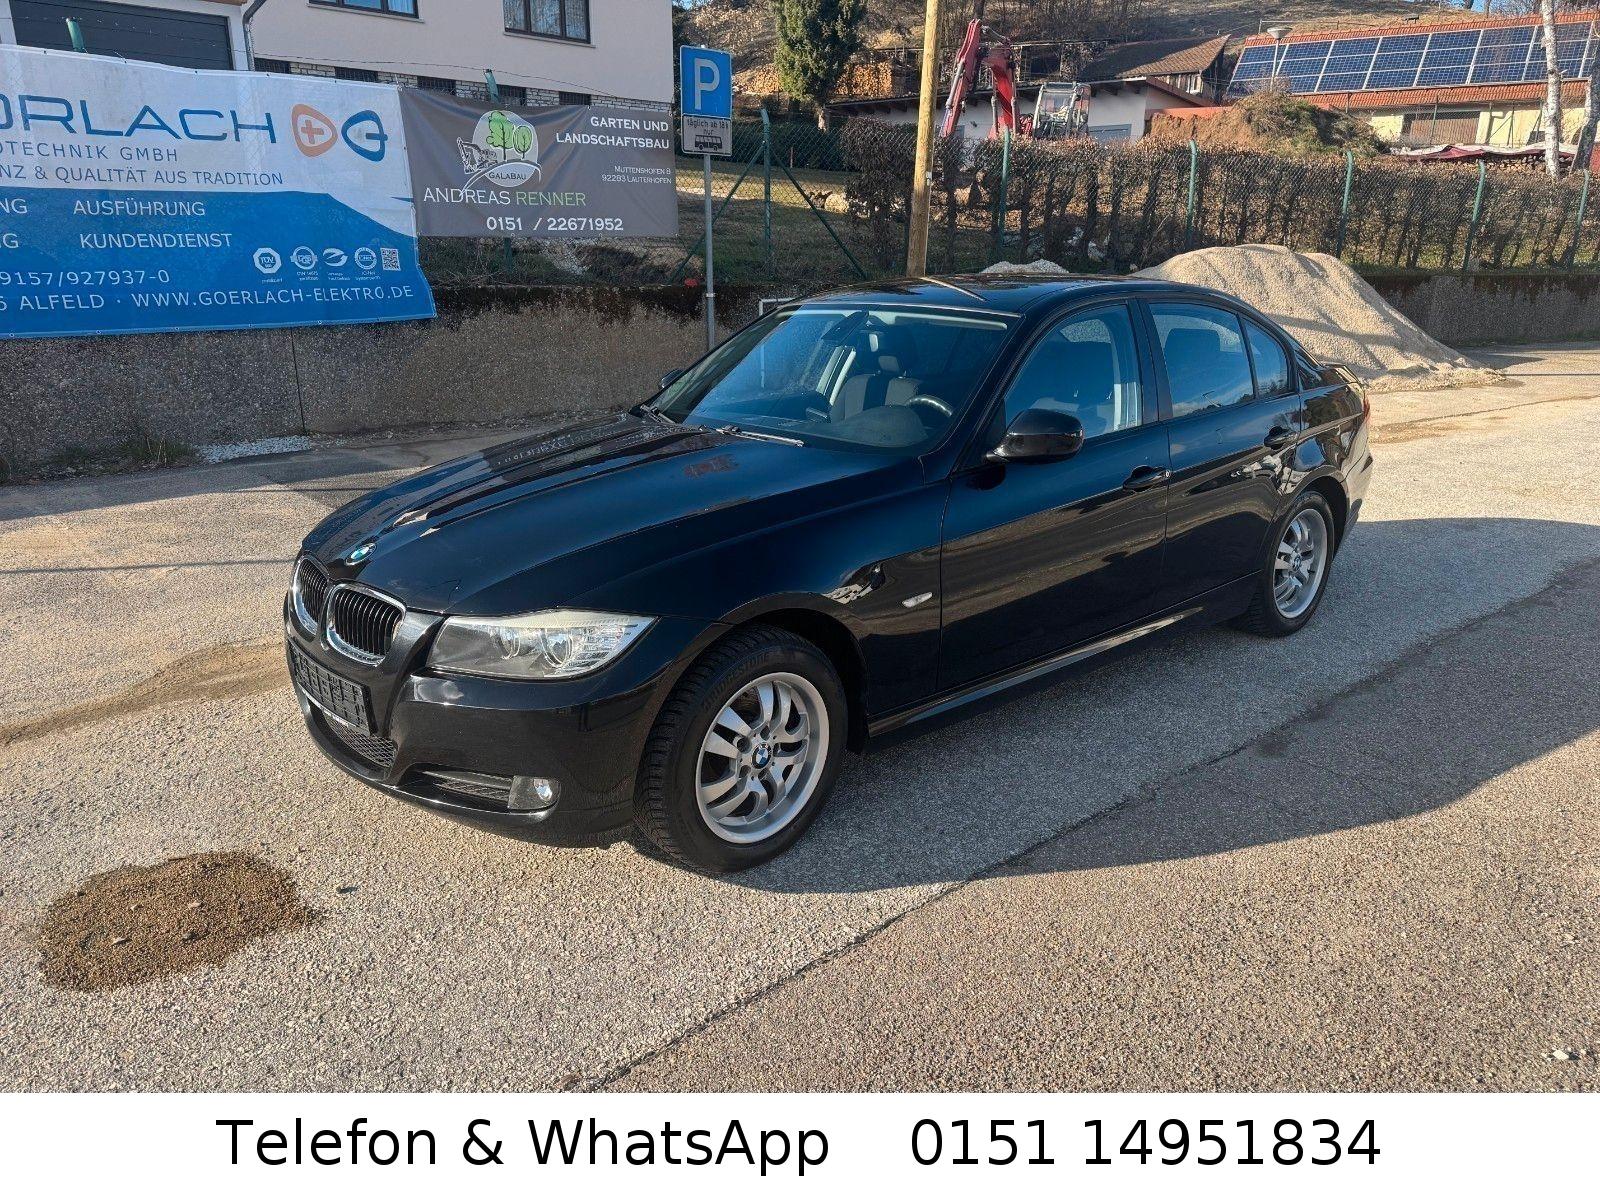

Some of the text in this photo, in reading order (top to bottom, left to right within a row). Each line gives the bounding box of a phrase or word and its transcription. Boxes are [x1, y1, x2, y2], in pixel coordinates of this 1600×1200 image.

[694, 57, 720, 110] P
[0, 93, 277, 144] RLACH
[590, 116, 669, 132] GARTEN UND
[556, 132, 670, 149] LANDSCHAFTSBAU
[0, 140, 178, 162] TECHNIK GMBH
[34, 165, 48, 180] &
[55, 165, 147, 184] QUALITÄT
[154, 170, 187, 184] AUS
[192, 171, 284, 186] TRADITION
[488, 172, 527, 181] GALABAU
[423, 187, 587, 207] ANDREAS RENNER
[73, 198, 206, 216] AUSFÜHRUNG
[486, 216, 624, 232] 0151 / 22671952
[80, 233, 232, 249] KUNDENDIENST
[0, 269, 170, 287] 9157/927937-0
[20, 293, 105, 310] ALFELD
[131, 285, 414, 307] WWW.GOERLACH-ELEKTRO.DE
